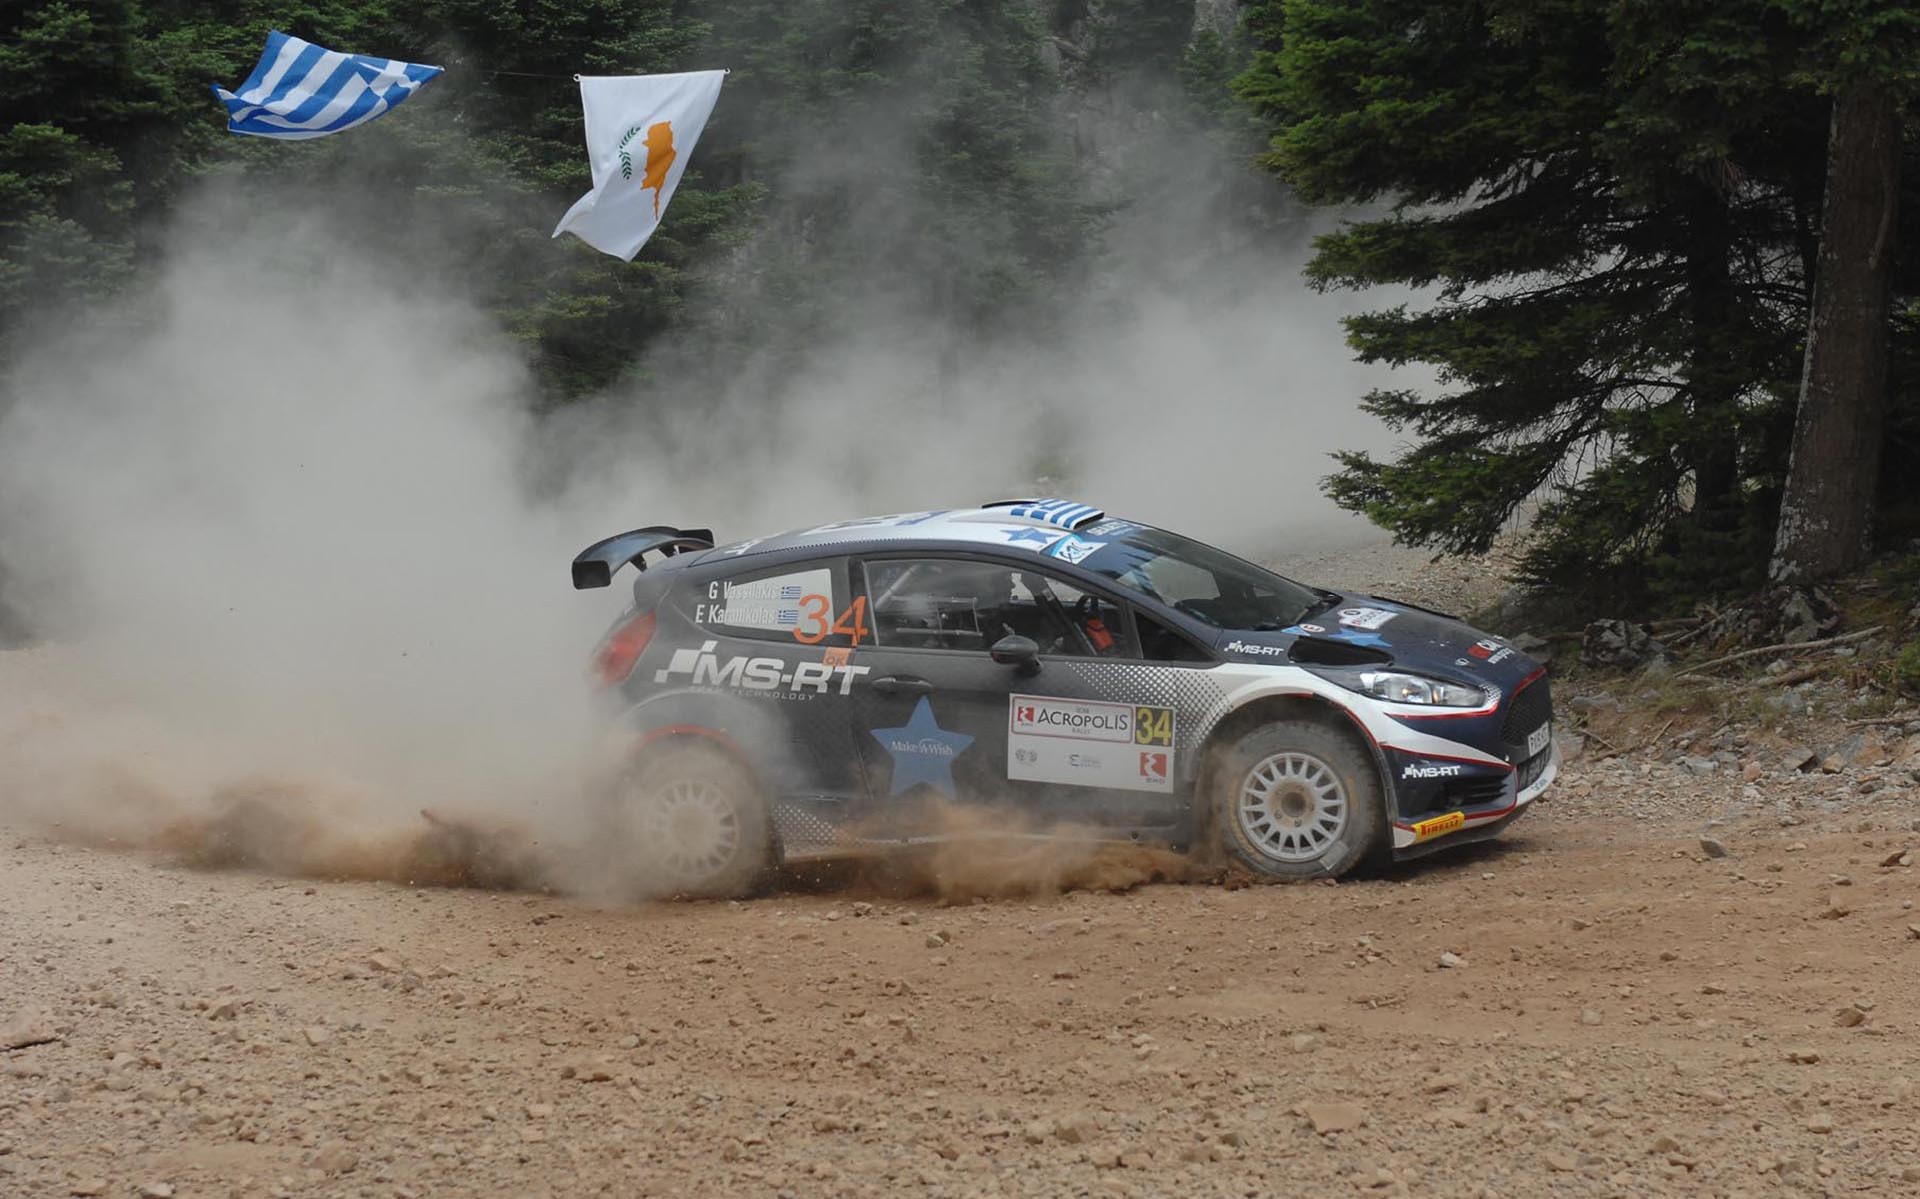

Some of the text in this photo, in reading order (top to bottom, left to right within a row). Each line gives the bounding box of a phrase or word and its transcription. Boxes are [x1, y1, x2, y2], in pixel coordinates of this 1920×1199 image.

[709, 581, 718, 600] G
[696, 604, 705, 624] E
[793, 594, 869, 647] 34
[1235, 643, 1285, 656] MS-RT
[826, 656, 845, 667] OK
[692, 653, 871, 696] MS-RT
[1037, 706, 1172, 747] ACROPOLIS 34
[1412, 765, 1461, 778] MS-RT
[1420, 815, 1460, 837] PIRELLI
